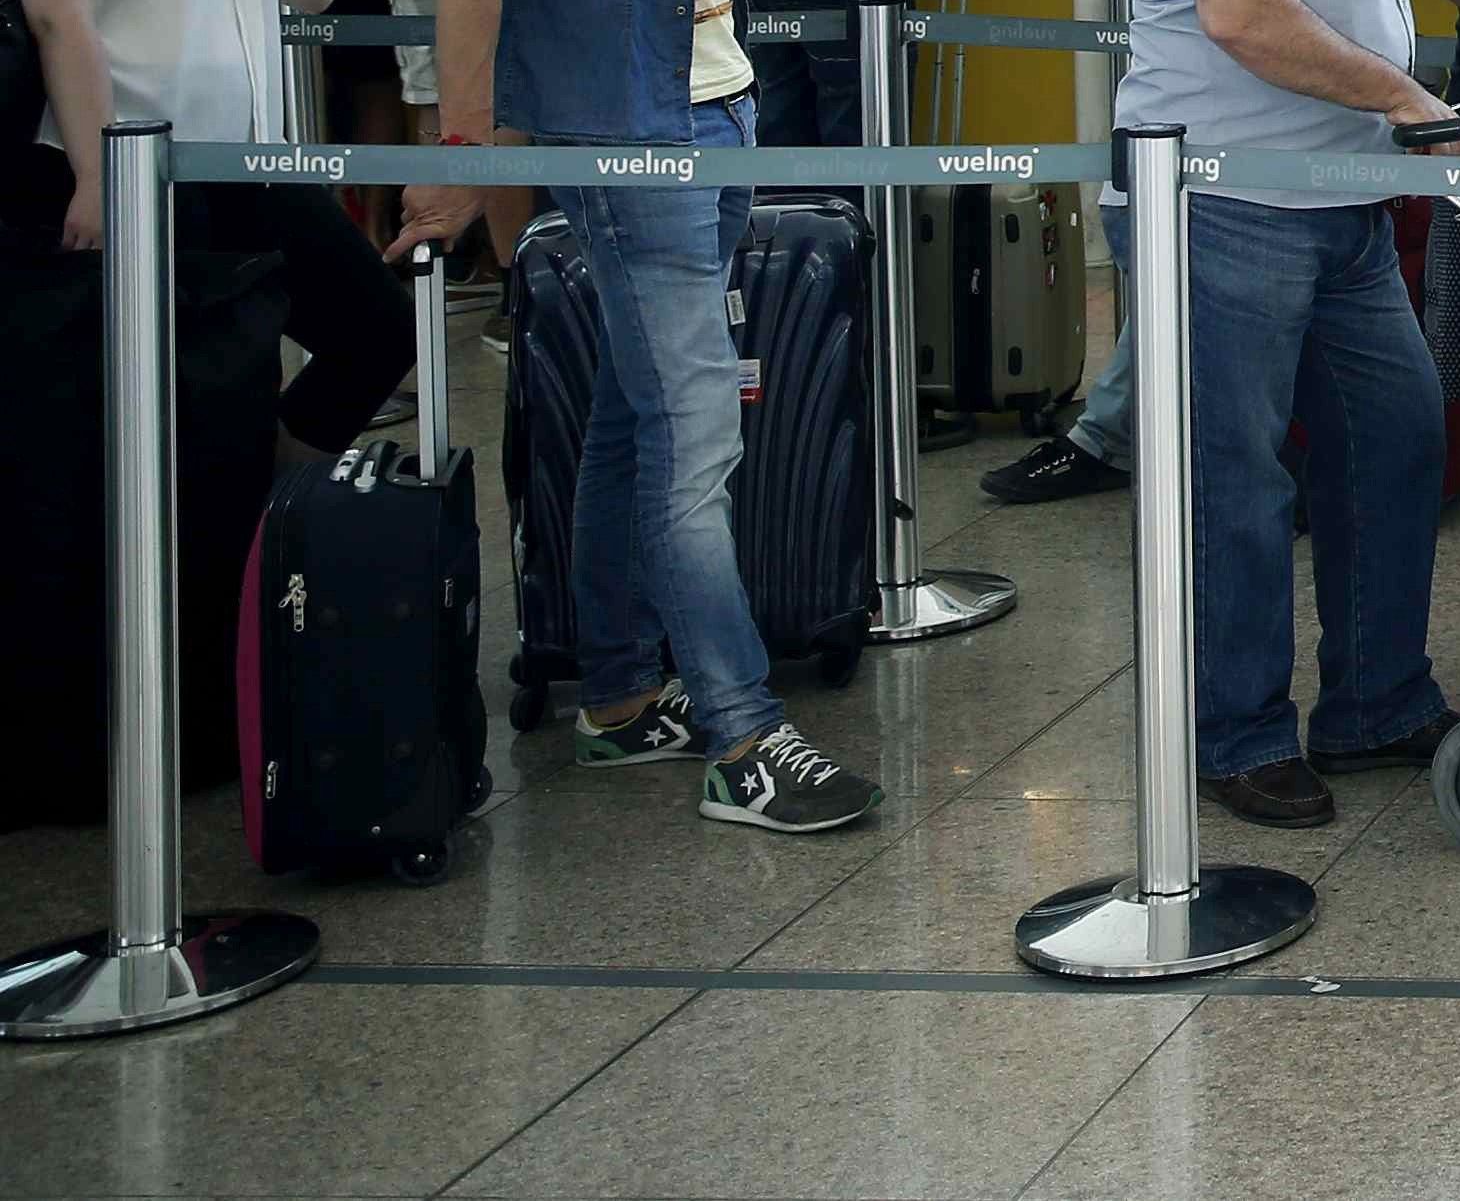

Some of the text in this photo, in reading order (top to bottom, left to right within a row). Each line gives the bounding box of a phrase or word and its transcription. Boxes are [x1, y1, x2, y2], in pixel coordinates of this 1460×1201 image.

[244, 147, 352, 179] vueling
[596, 150, 701, 182] vueling
[938, 148, 1040, 179] vueling
